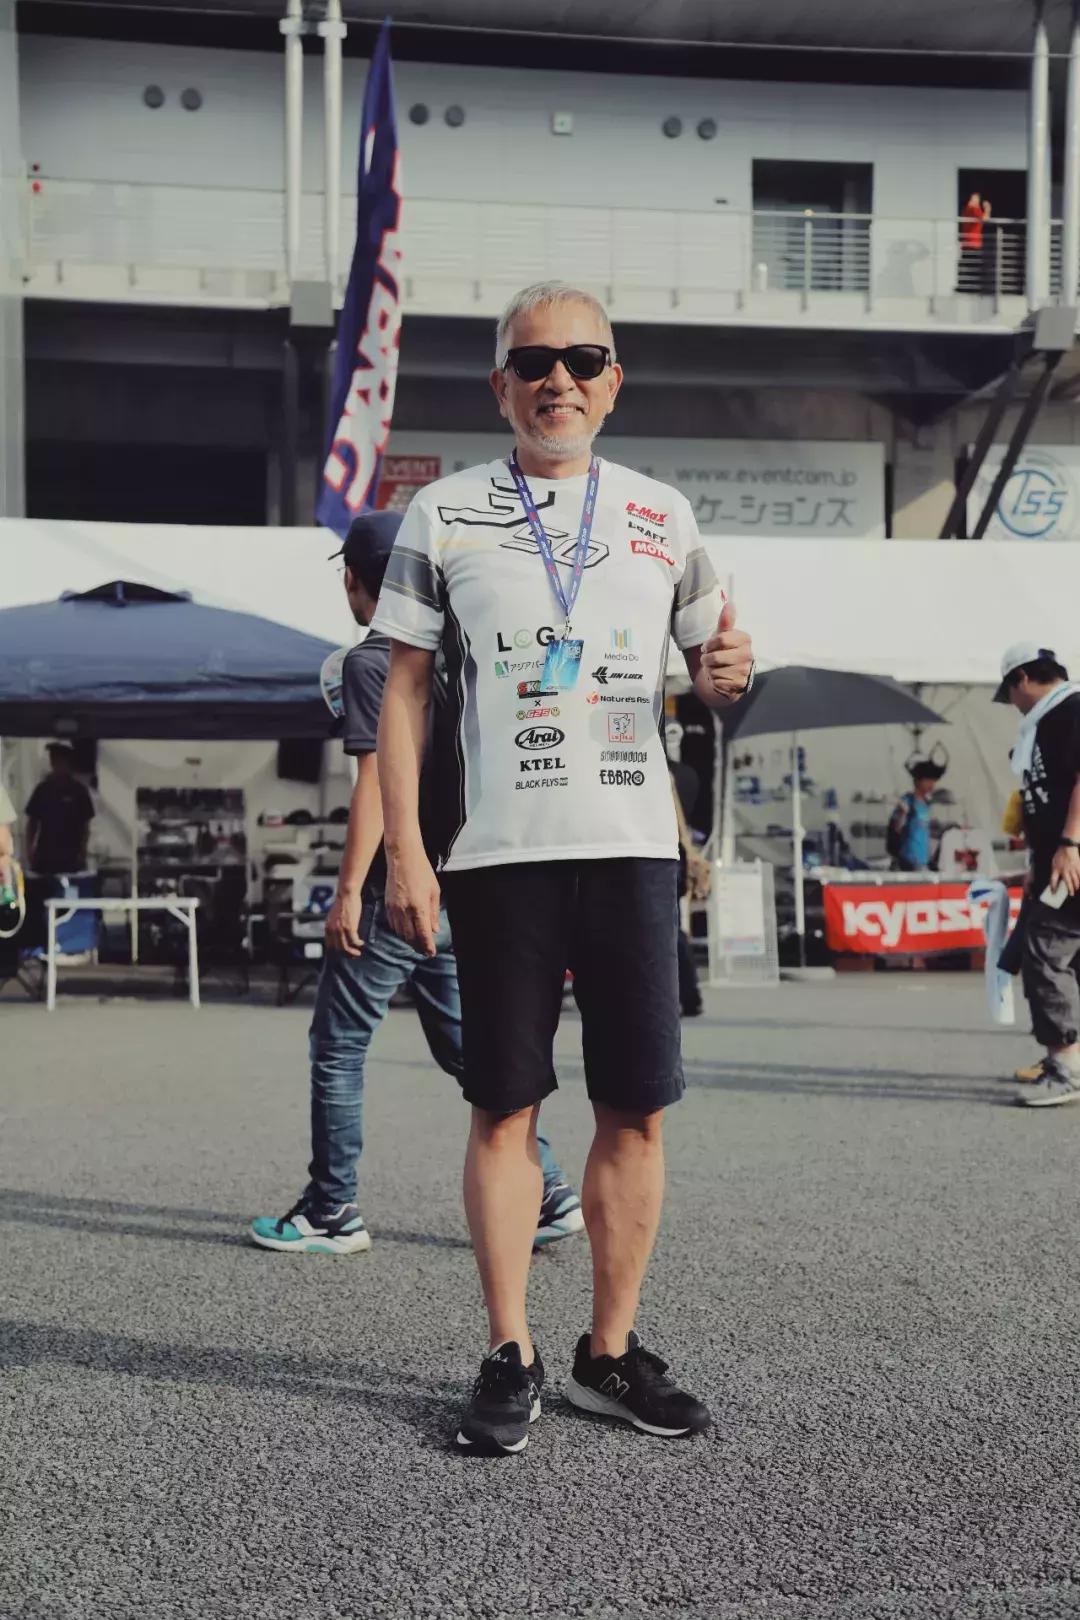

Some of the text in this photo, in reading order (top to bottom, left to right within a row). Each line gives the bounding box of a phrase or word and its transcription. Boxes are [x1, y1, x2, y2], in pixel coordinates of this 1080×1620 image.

[519, 729, 560, 744] Arai
[520, 757, 566, 772] KTEL
[515, 779, 541, 790] BLACK
[541, 776, 560, 788] FLYS
